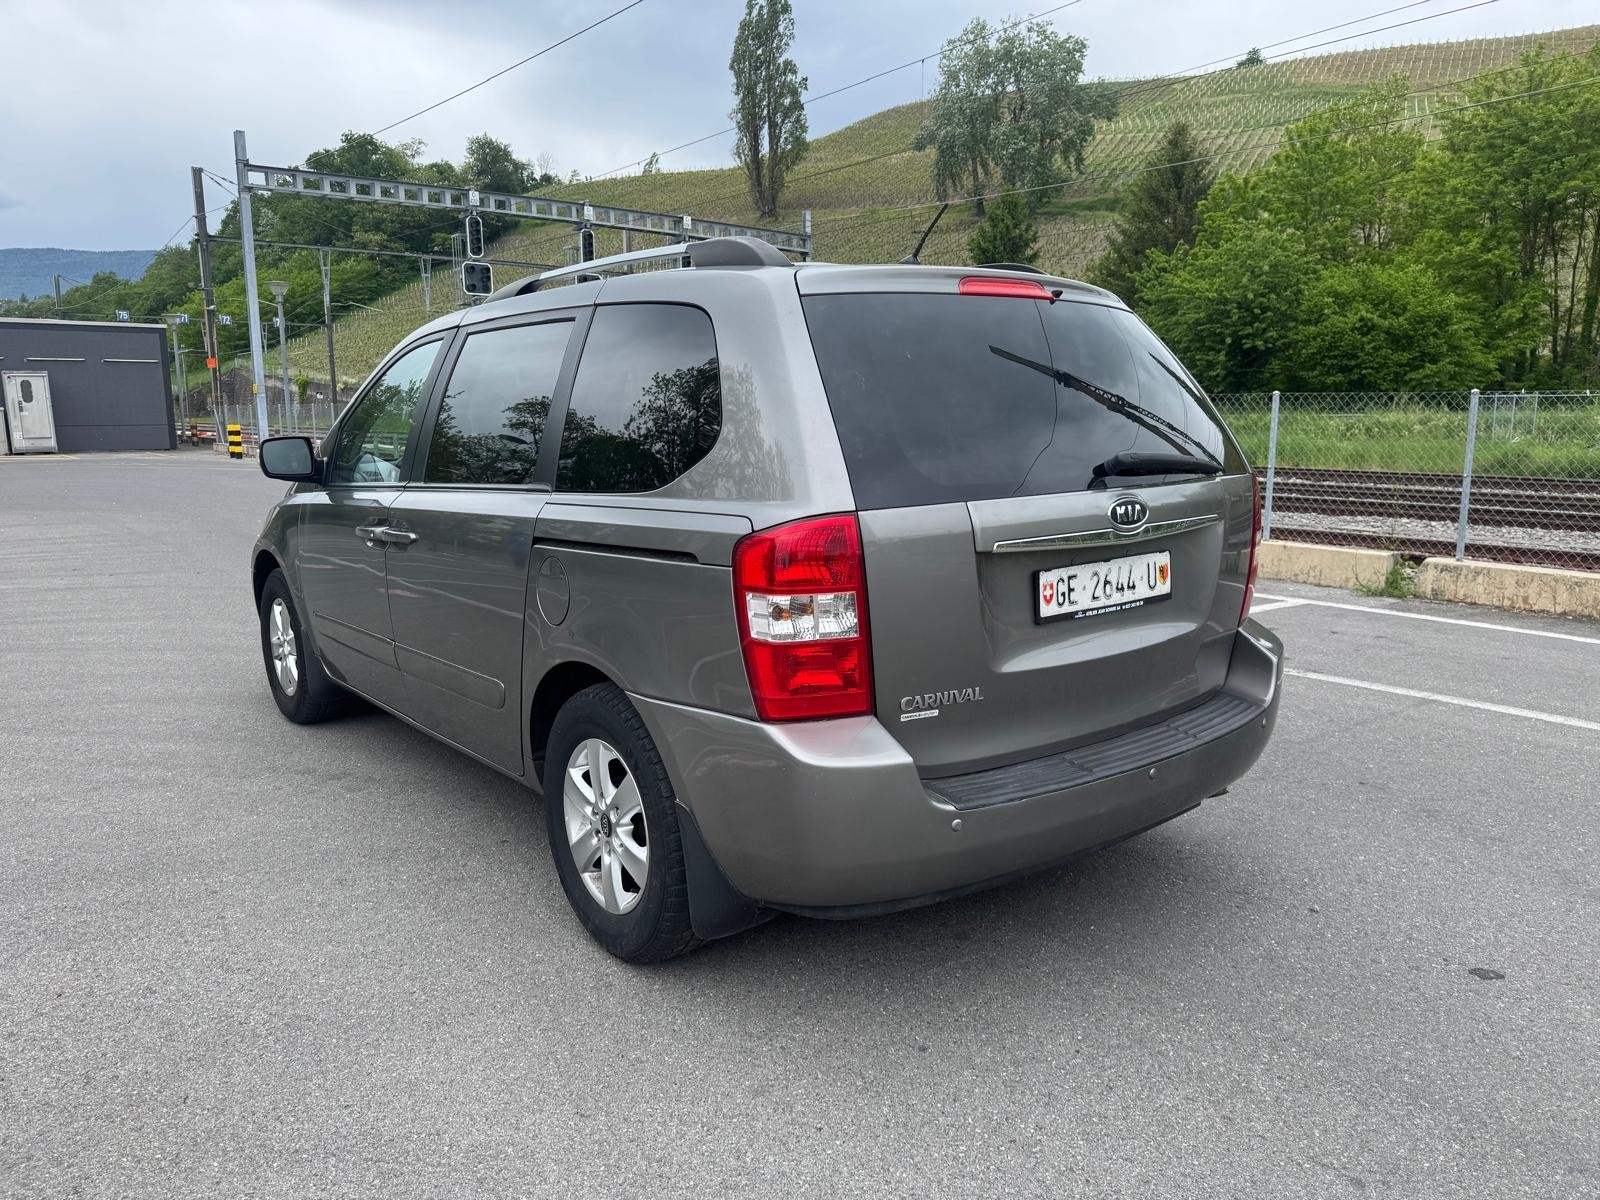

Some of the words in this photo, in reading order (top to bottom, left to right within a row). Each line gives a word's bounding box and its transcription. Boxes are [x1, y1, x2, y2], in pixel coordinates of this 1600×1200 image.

[118, 311, 128, 320] 75
[221, 315, 231, 324] 72
[1115, 504, 1144, 523] KIA
[1056, 573, 1079, 608] GE
[1090, 563, 1137, 602] 2644
[1147, 560, 1157, 591] U
[900, 687, 985, 711] CARNIVAL
